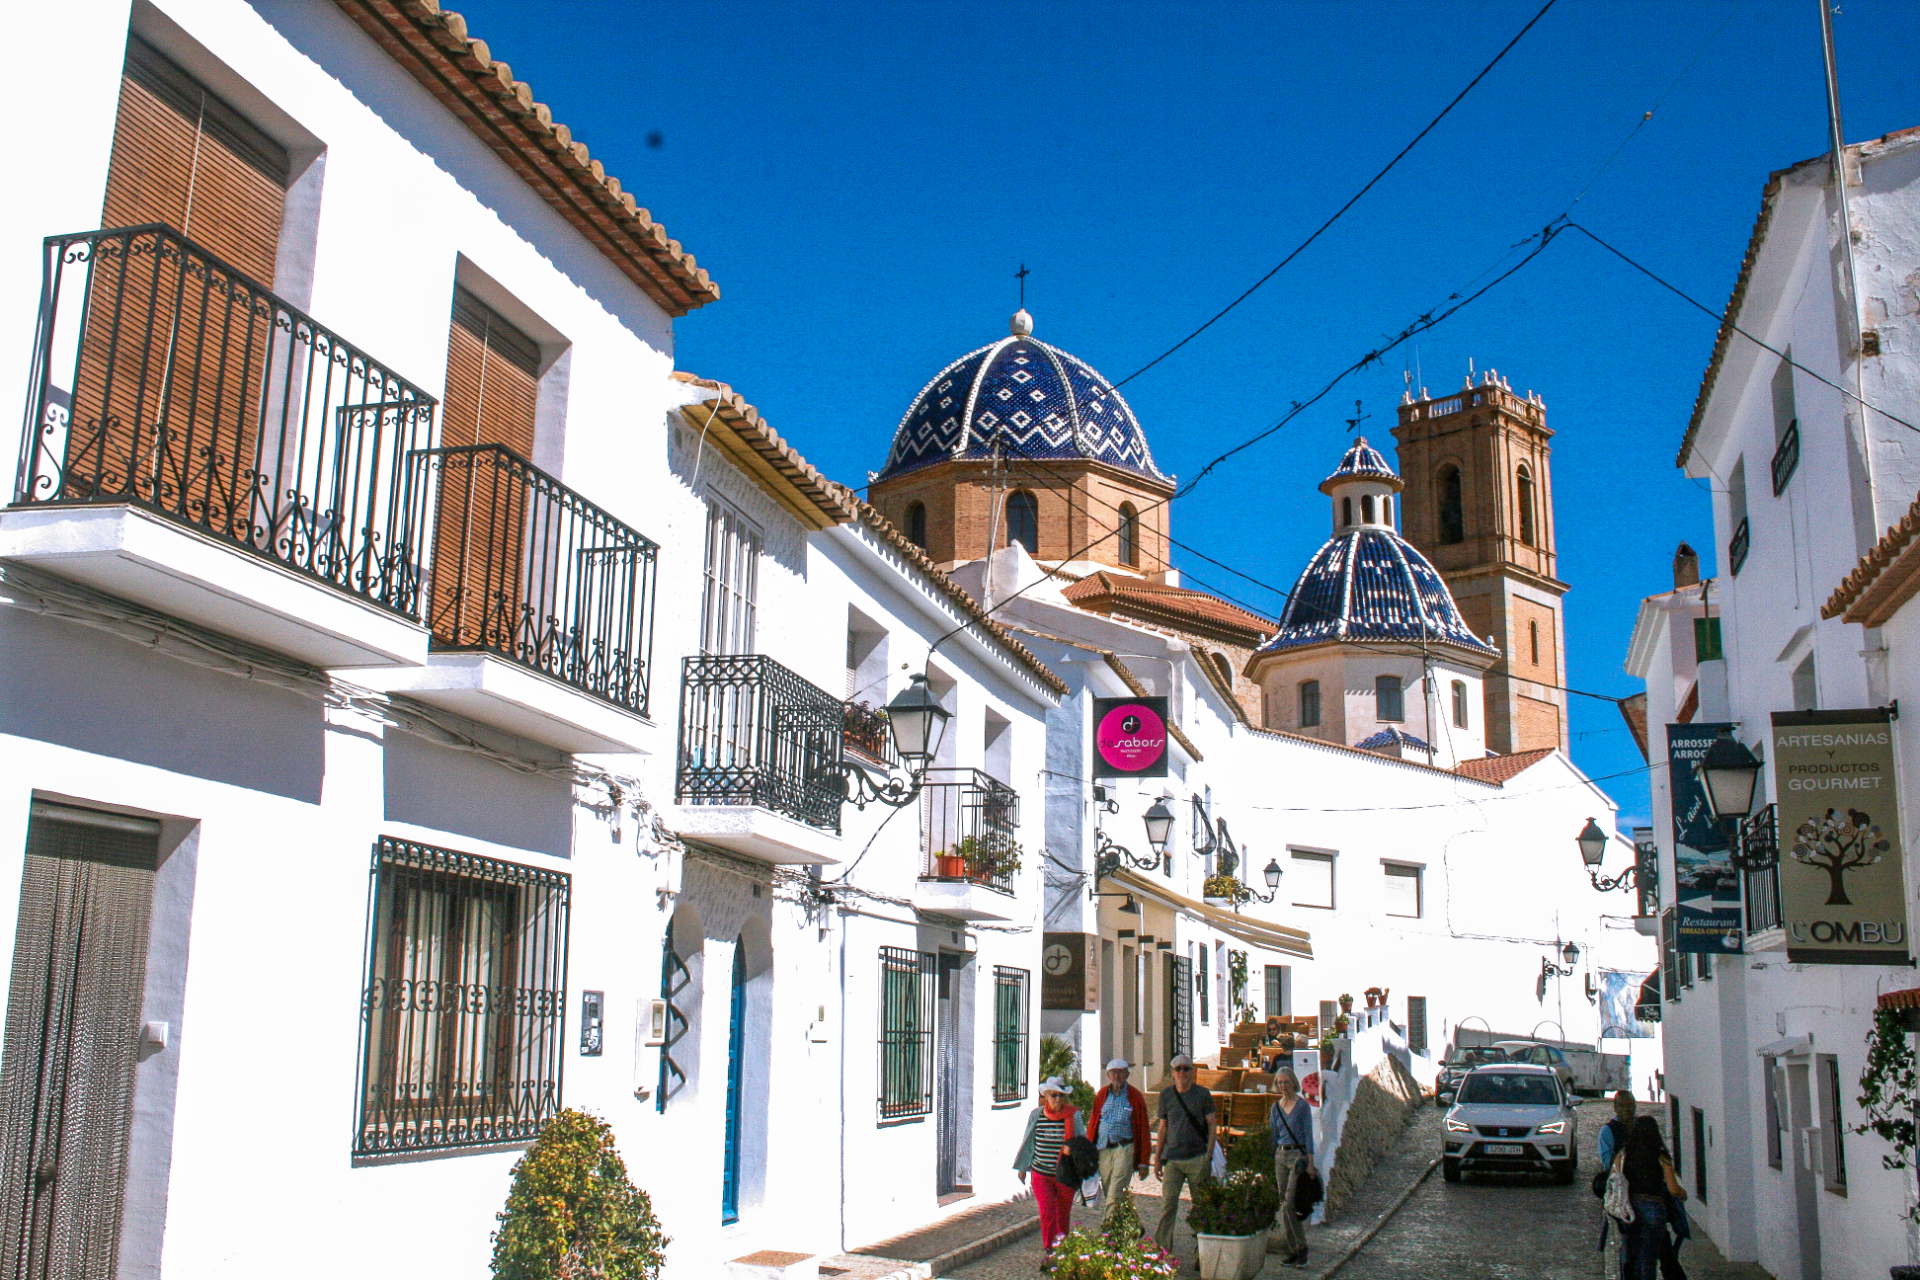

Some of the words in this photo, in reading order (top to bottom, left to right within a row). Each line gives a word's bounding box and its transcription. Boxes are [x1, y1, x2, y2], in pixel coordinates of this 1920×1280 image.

[1670, 739, 1717, 749] ARROSSE
[1776, 732, 1889, 748] ARTESANIAS
[1673, 749, 1709, 759] ARROC
[1826, 749, 1836, 759] Y
[1789, 762, 1881, 774] PRODUCTOS
[1788, 776, 1883, 791] GOURMET
[1682, 916, 1737, 927] Restaurant
